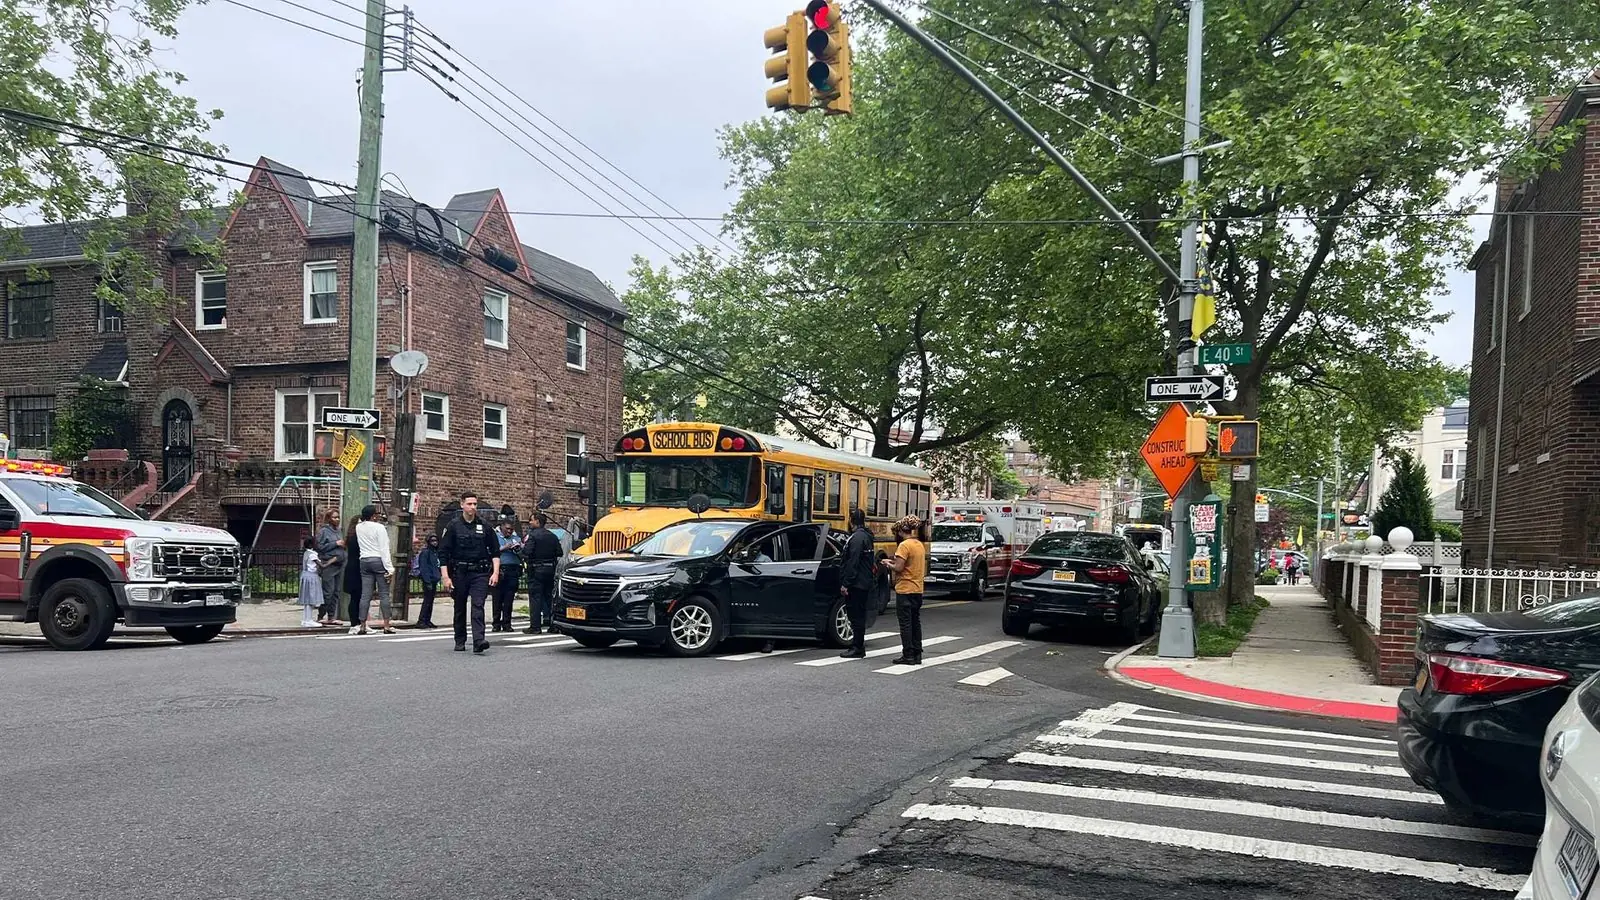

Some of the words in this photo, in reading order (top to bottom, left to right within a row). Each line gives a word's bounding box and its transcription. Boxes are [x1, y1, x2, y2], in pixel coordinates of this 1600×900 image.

[1203, 349, 1209, 362] E
[1214, 347, 1230, 362] 40
[1235, 346, 1243, 356] St
[1157, 384, 1178, 394] ONE
[1189, 383, 1212, 394] WAY
[331, 413, 347, 422] ONE
[355, 415, 371, 424] WAY
[655, 431, 690, 448] SCHOOL
[693, 431, 712, 448] BUS
[1147, 439, 1186, 454] CONSTRUC
[1161, 456, 1186, 469] AHEAD
